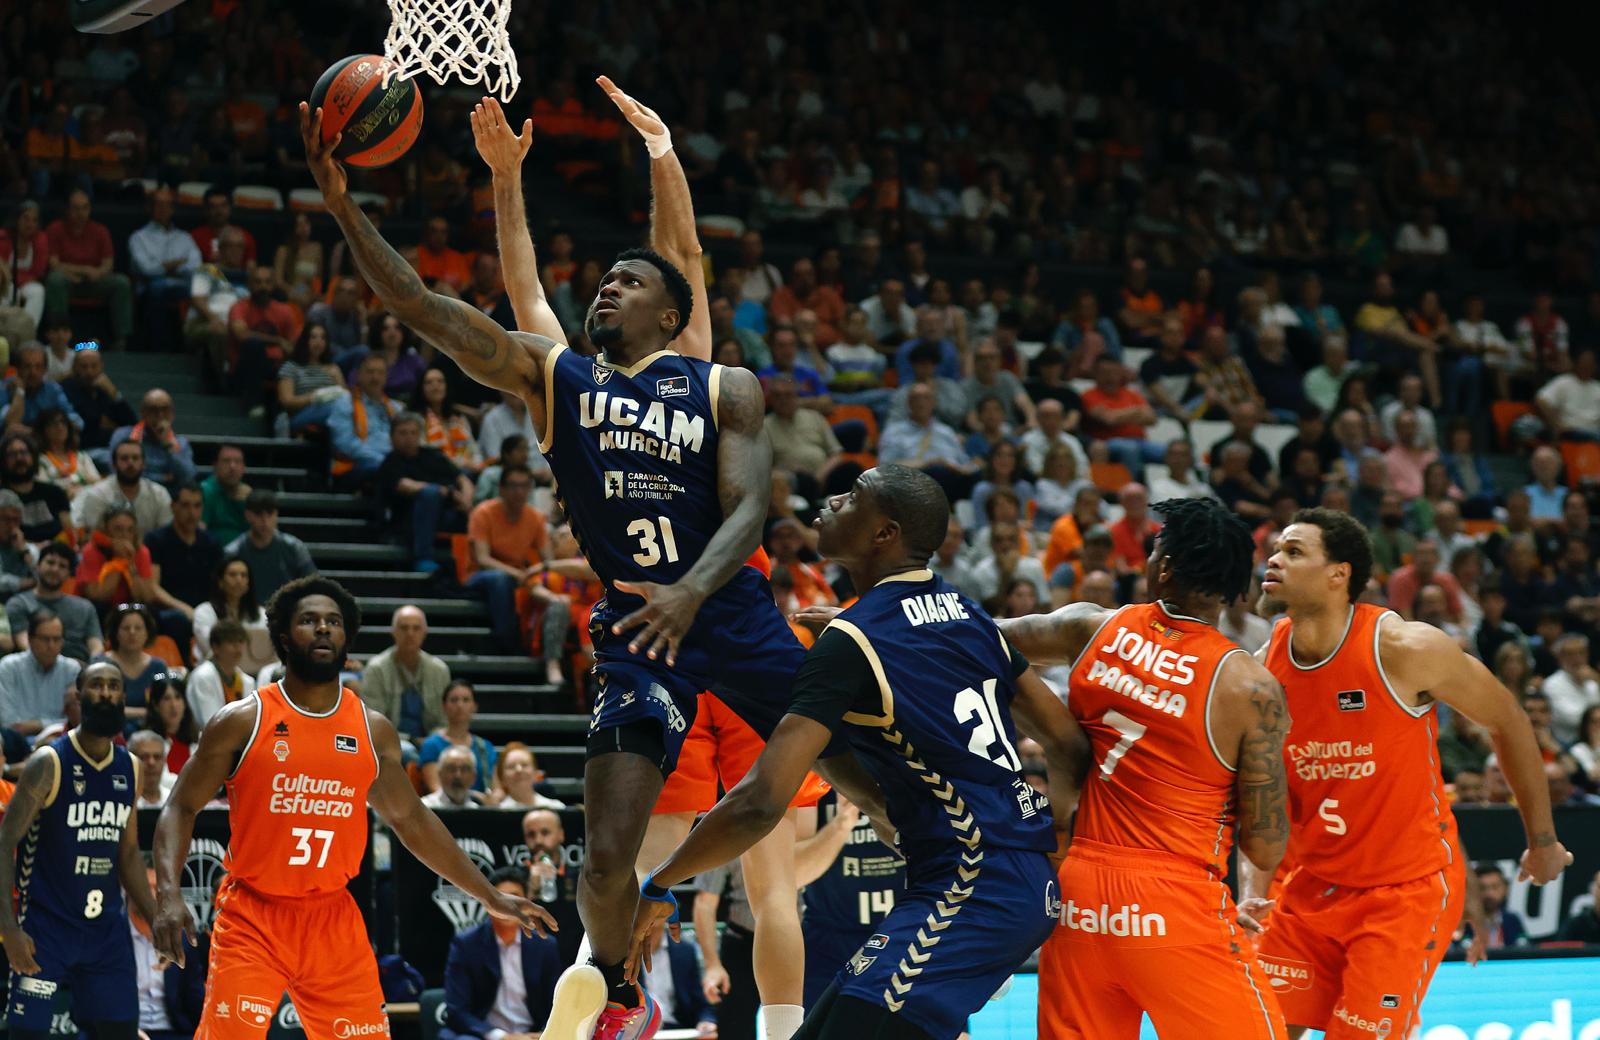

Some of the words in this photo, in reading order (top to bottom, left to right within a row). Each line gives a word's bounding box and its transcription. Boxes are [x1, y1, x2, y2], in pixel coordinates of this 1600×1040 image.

[579, 391, 705, 454] UCAM
[599, 431, 682, 464] MURCIA
[627, 472, 669, 483] CARAVACA
[627, 481, 638, 489] DE
[638, 482, 648, 490] LA
[648, 483, 668, 492] CRUZ
[627, 489, 644, 499] AÑO
[644, 491, 673, 500] JUBILAR
[626, 515, 679, 568] 31
[900, 592, 970, 628] DIAGNE
[1101, 626, 1200, 686] JONES
[1086, 659, 1188, 719] PAMESA
[1098, 708, 1148, 782] 7
[1287, 740, 1352, 761] Cultura
[1353, 743, 1374, 757] del
[271, 772, 342, 796] Cultura
[340, 786, 356, 798] del
[1295, 760, 1377, 780] Esfuerzo
[269, 793, 354, 818] Esfuerzo
[1318, 798, 1348, 836] 5
[288, 827, 335, 869] 37
[84, 889, 104, 919] 8
[858, 889, 895, 925] 14
[1060, 899, 1167, 937] italdin
[343, 1021, 384, 1038] Midea
